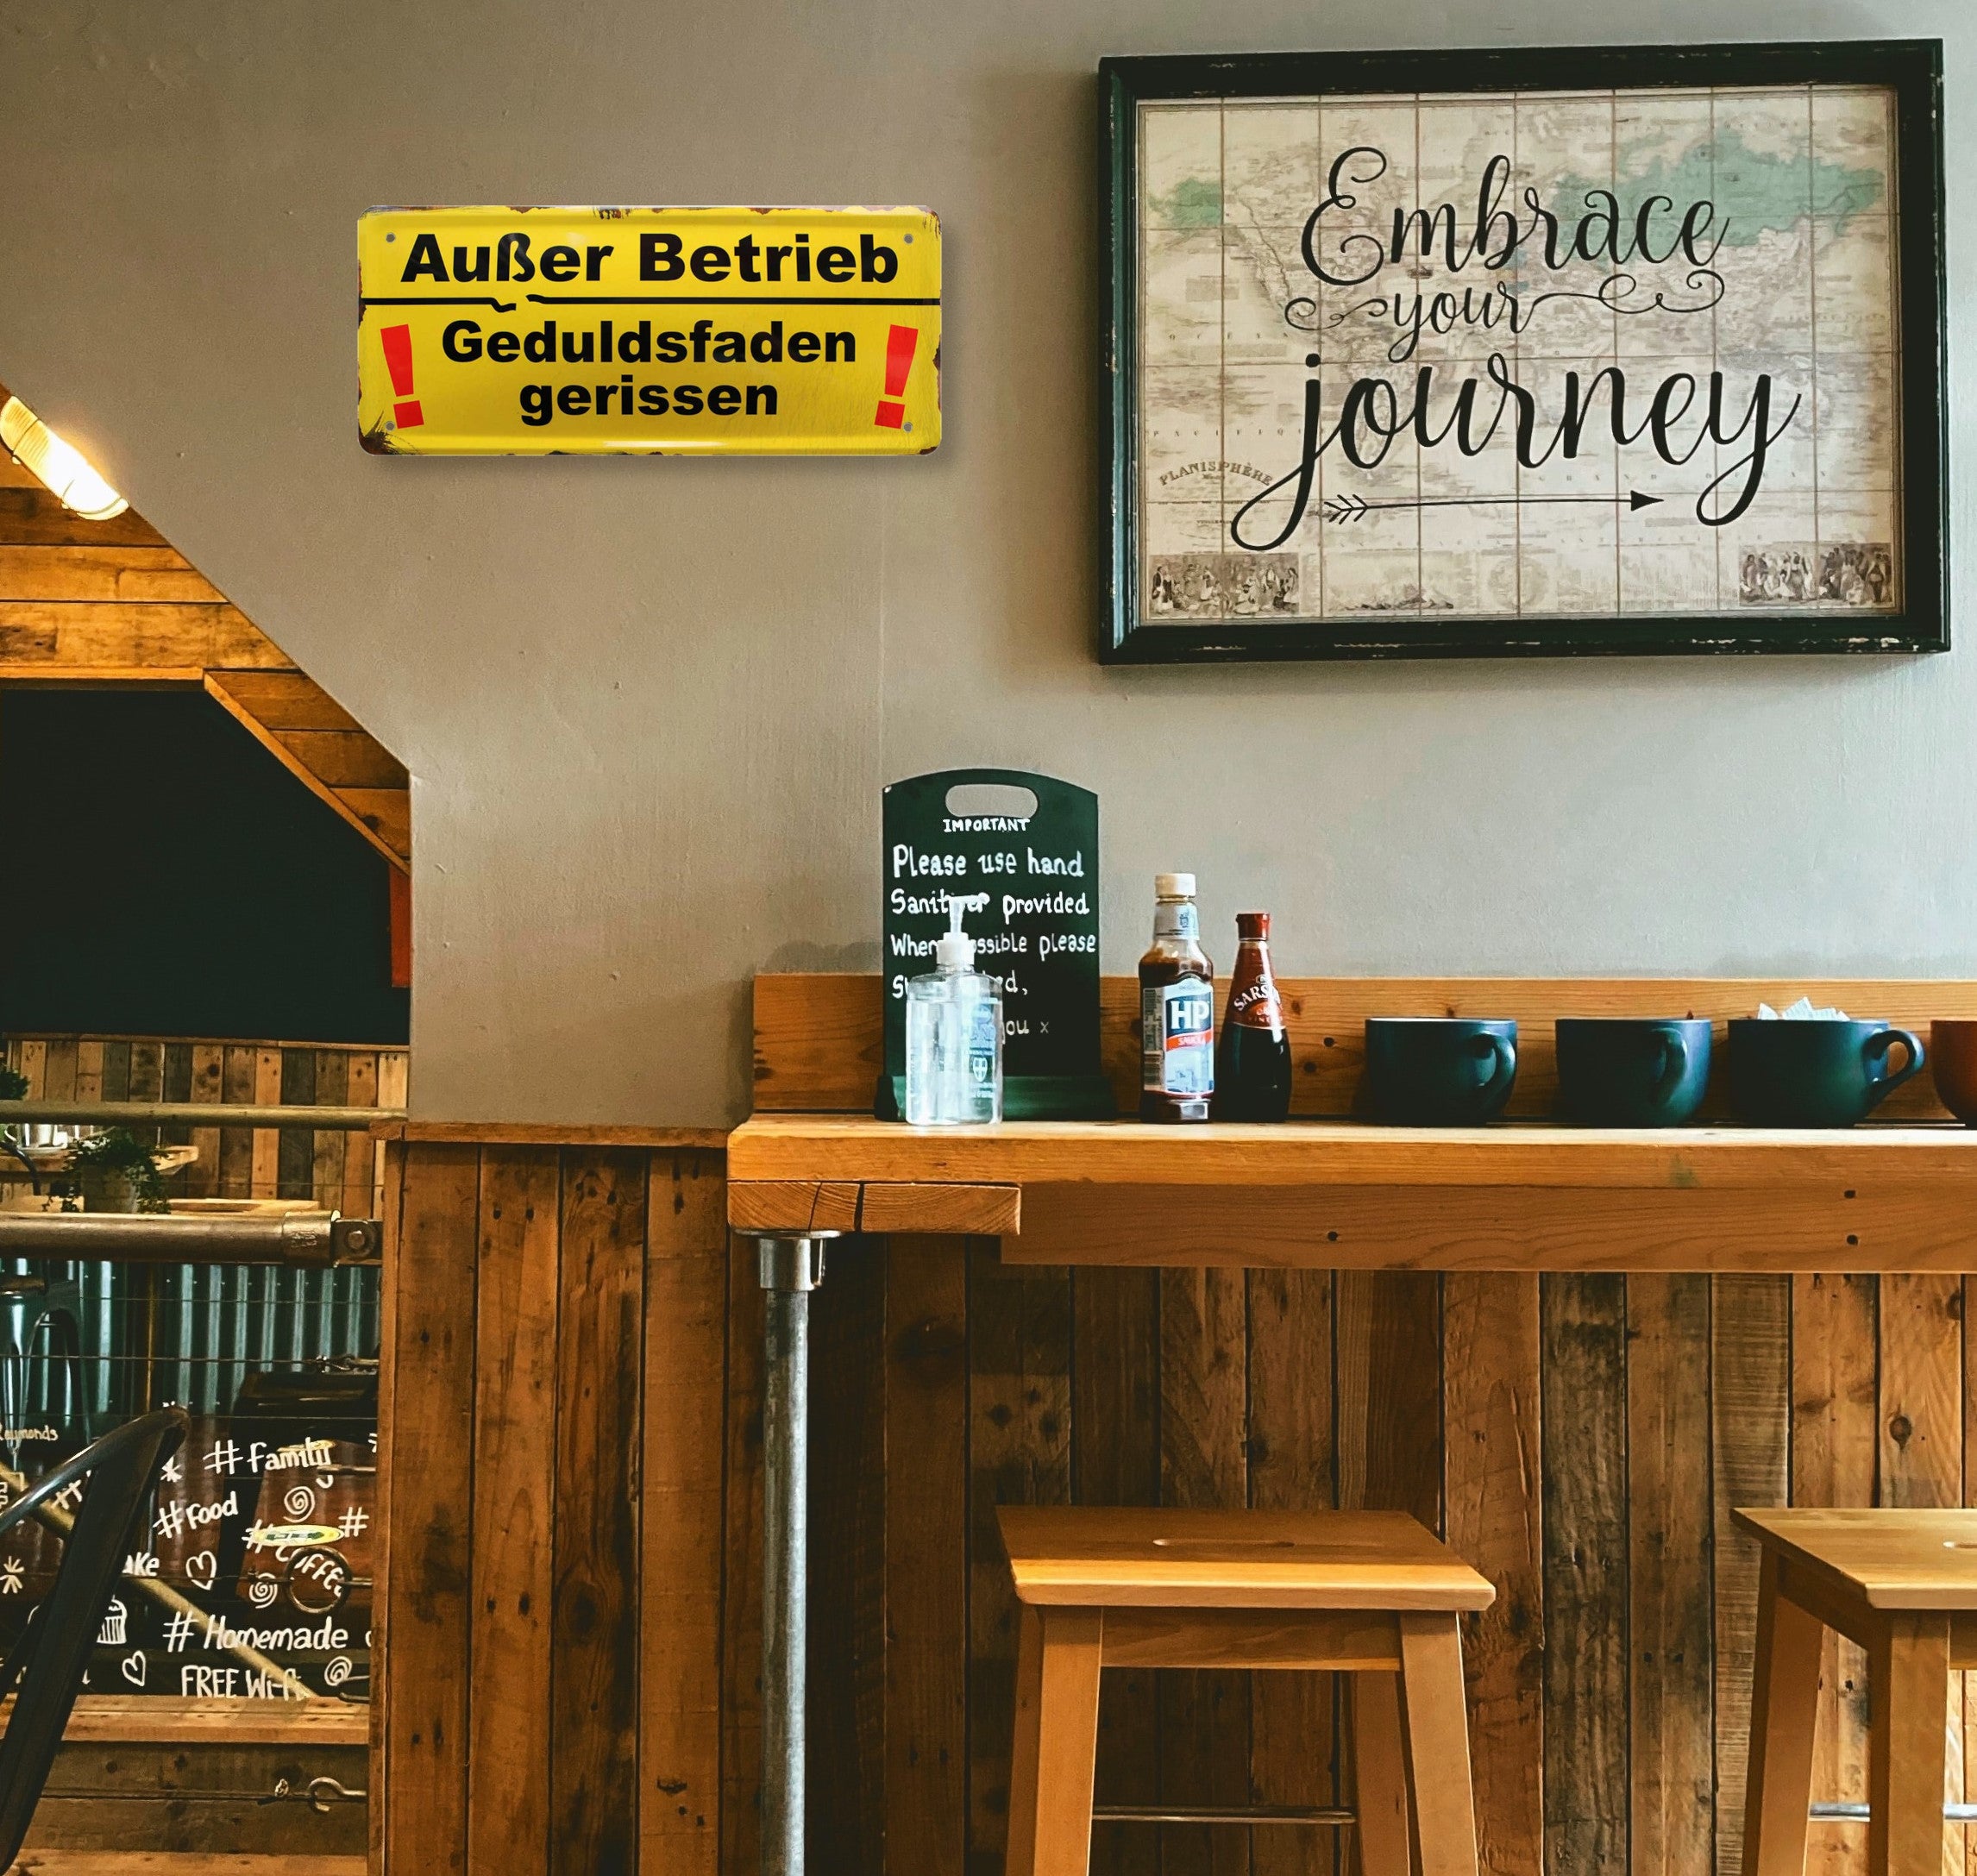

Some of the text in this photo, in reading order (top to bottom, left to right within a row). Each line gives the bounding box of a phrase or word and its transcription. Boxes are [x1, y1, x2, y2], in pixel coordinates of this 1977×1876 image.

[1302, 147, 1730, 286] Embrace
[400, 233, 898, 284] Außer Betrieb
[1387, 280, 1540, 363] your
[442, 319, 856, 364] Geduldsfaden
[519, 373, 778, 427] gerissen
[1231, 352, 1802, 551] journey
[1159, 461, 1274, 486] PLANISPHÈRE
[943, 818, 1031, 833] IMPORTANT
[893, 844, 1085, 878] Please use hand
[1002, 891, 1090, 925] provided
[1039, 934, 1096, 962] please
[1171, 1001, 1210, 1029] HP
[181, 1665, 240, 1698] FREE
